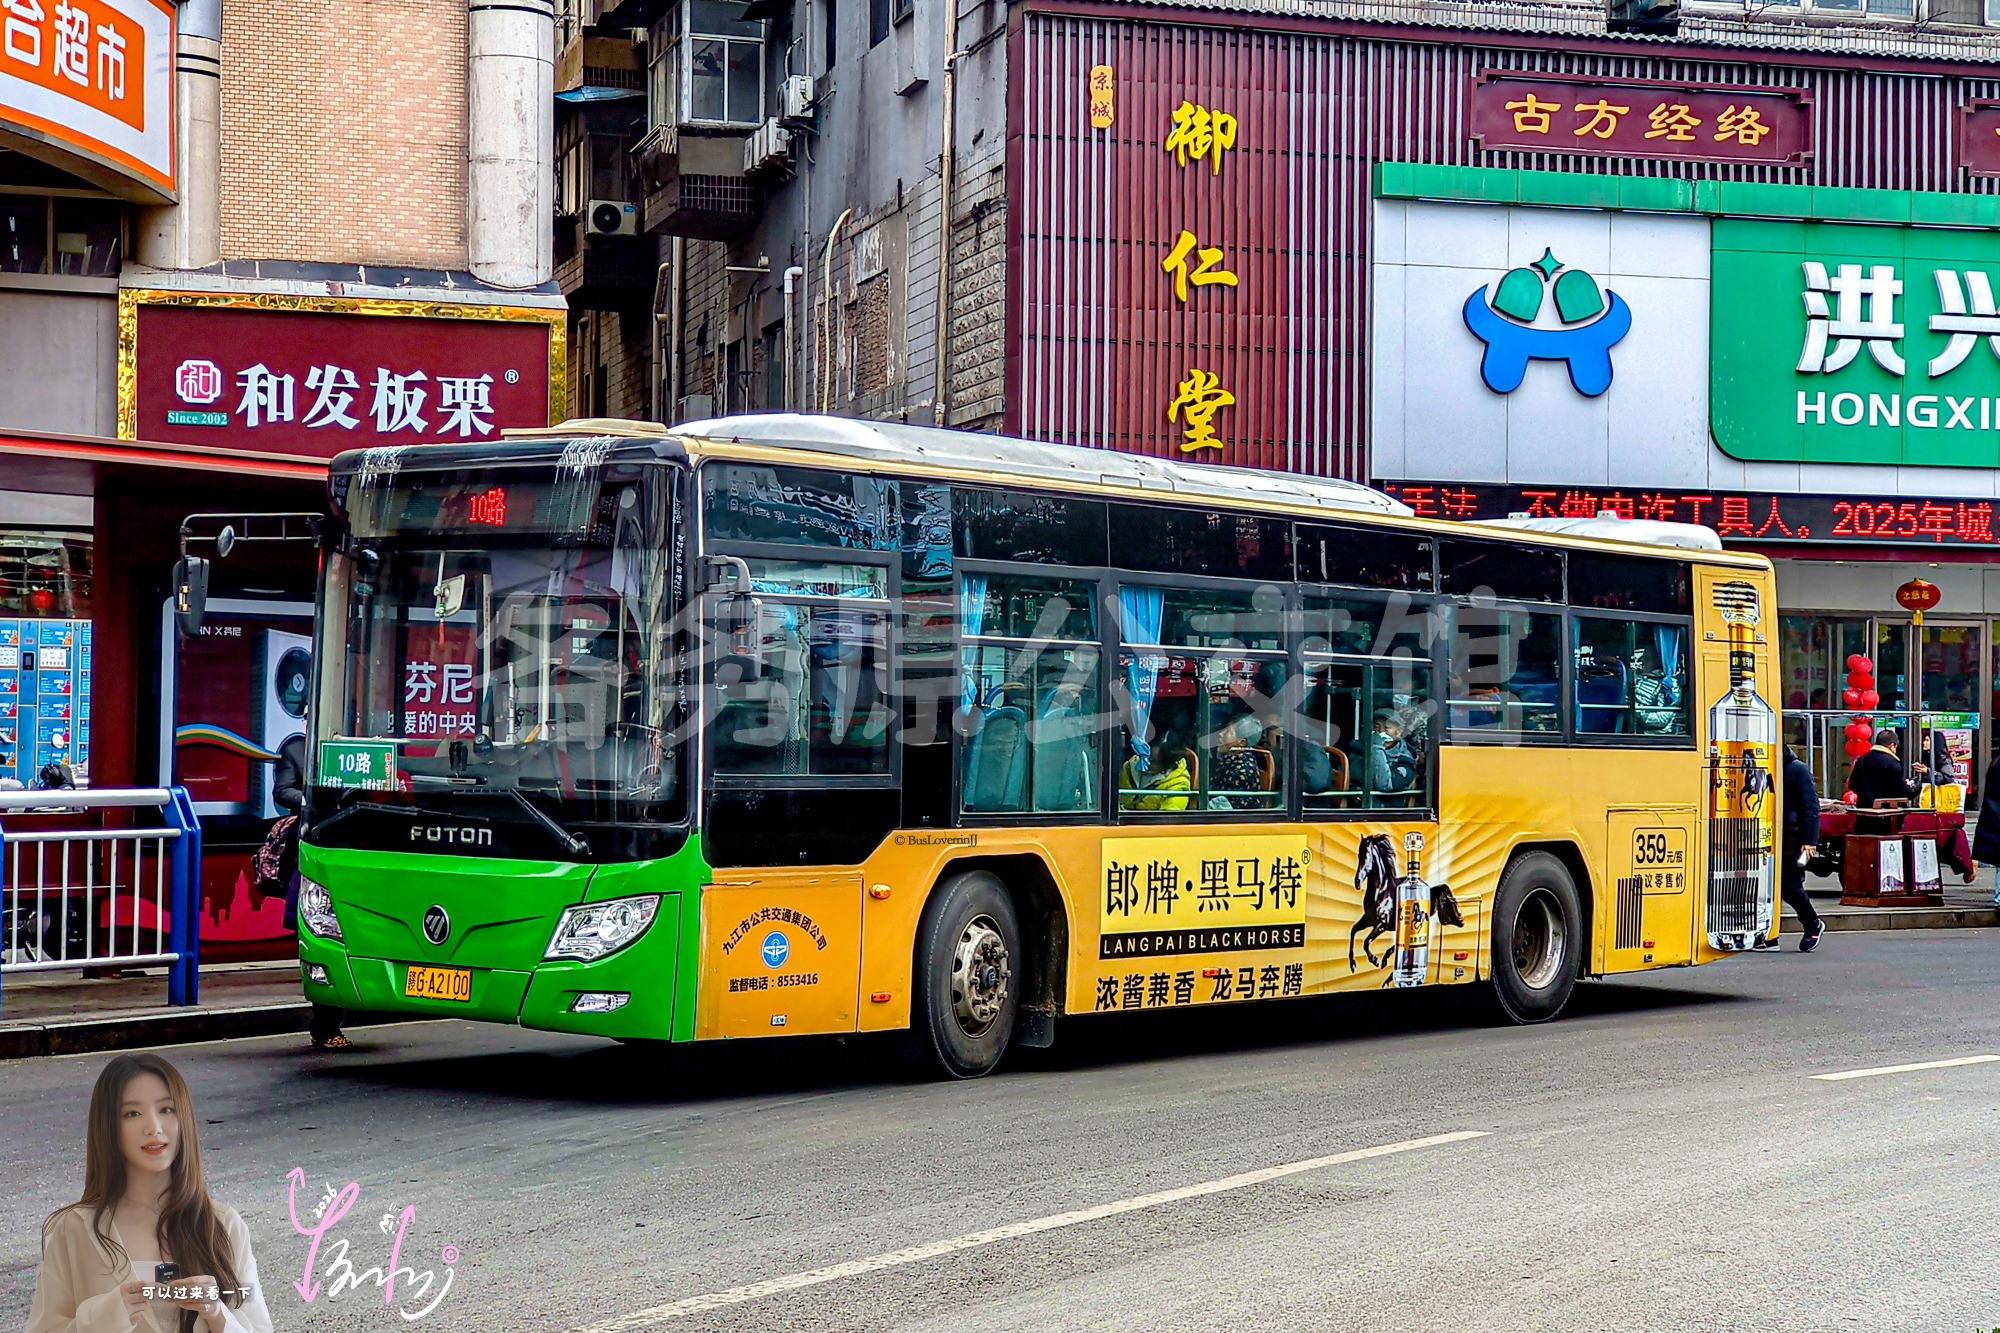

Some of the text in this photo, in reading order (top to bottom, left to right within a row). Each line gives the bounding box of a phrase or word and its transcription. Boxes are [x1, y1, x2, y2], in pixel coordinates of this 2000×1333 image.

[1505, 93, 1770, 146] 古方经络
[1162, 101, 1239, 453] 御仁堂
[1796, 261, 2000, 379] 洪兴
[167, 411, 228, 425] Since 2002
[235, 363, 495, 438] 和发板栗
[1796, 390, 2000, 430] HONGXI
[469, 487, 506, 526] 10路
[1832, 500, 2000, 543] 2025年城
[405, 661, 474, 704] 芬尼
[338, 752, 371, 774] 10路
[411, 825, 492, 845] FOTON
[722, 907, 828, 955] 九江市公共交通集团公司
[1103, 928, 1302, 955] LANG PAI BLACK HORSE
[1095, 963, 1303, 1011] 浓酱兼香 龙马奔腾
